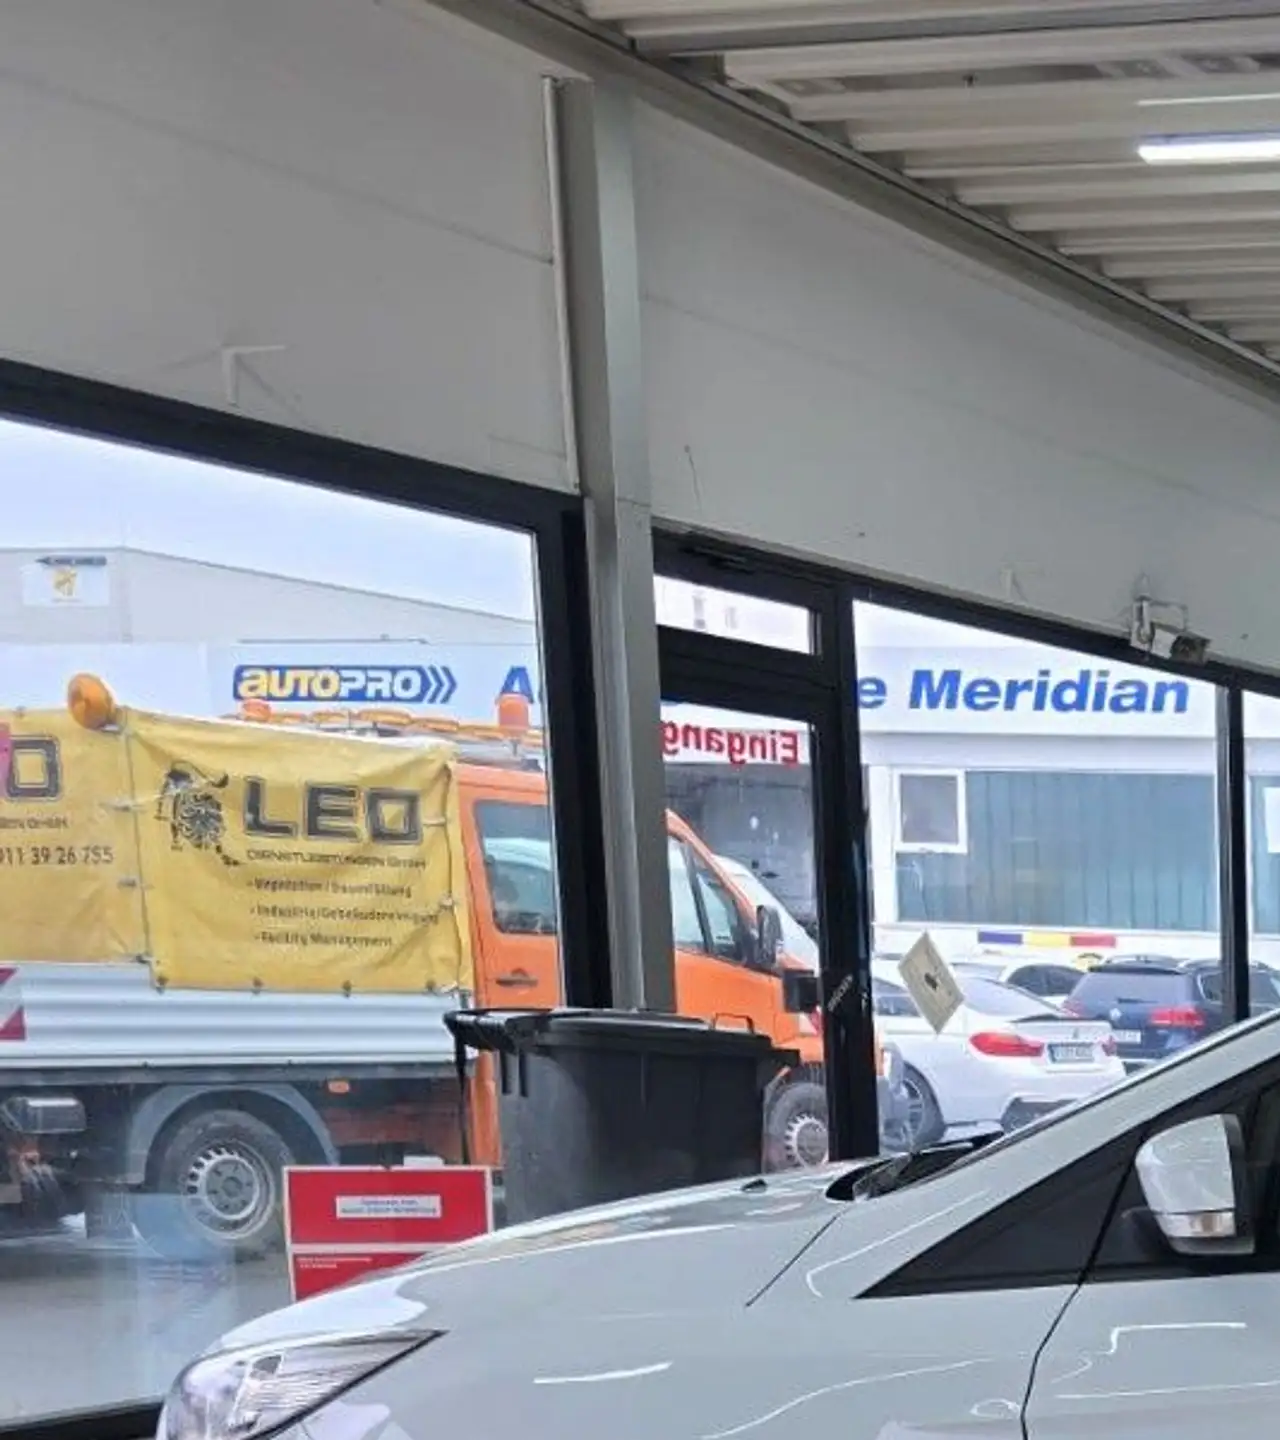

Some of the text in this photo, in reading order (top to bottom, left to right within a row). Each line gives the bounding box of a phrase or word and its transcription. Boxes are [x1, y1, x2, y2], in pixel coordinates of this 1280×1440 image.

[909, 669, 1189, 714] Meridian
[243, 775, 423, 845] LEO
[31, 847, 50, 865] 39
[57, 847, 77, 865] 26
